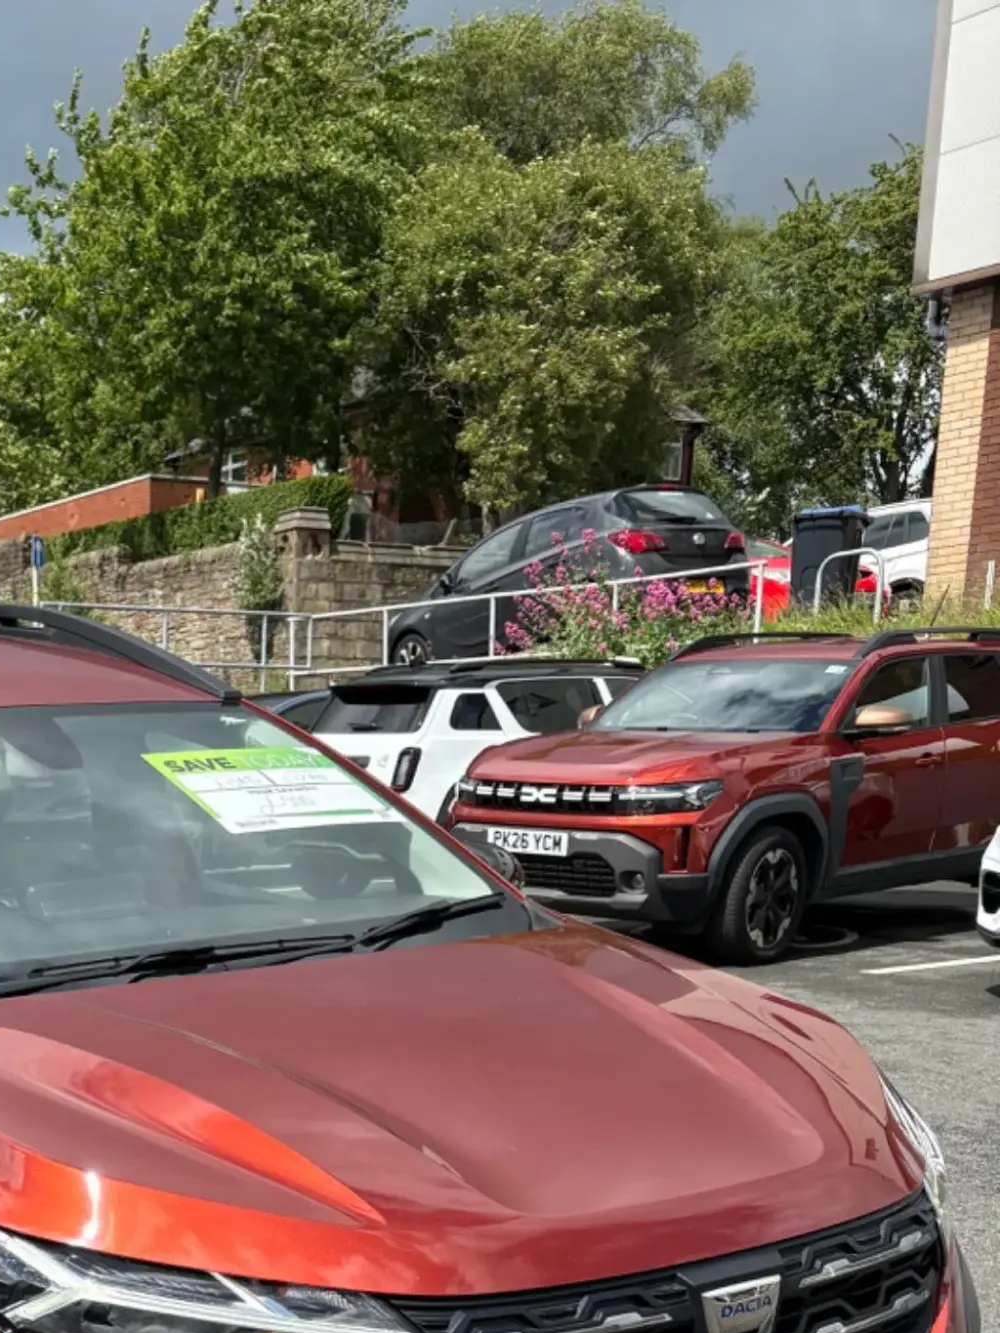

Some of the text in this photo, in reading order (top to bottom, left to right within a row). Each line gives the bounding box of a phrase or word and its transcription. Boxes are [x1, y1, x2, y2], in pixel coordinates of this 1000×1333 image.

[163, 752, 318, 774] SAVE TODAY
[493, 830, 562, 852] PK26 YCM
[721, 1296, 772, 1318] DACIA
